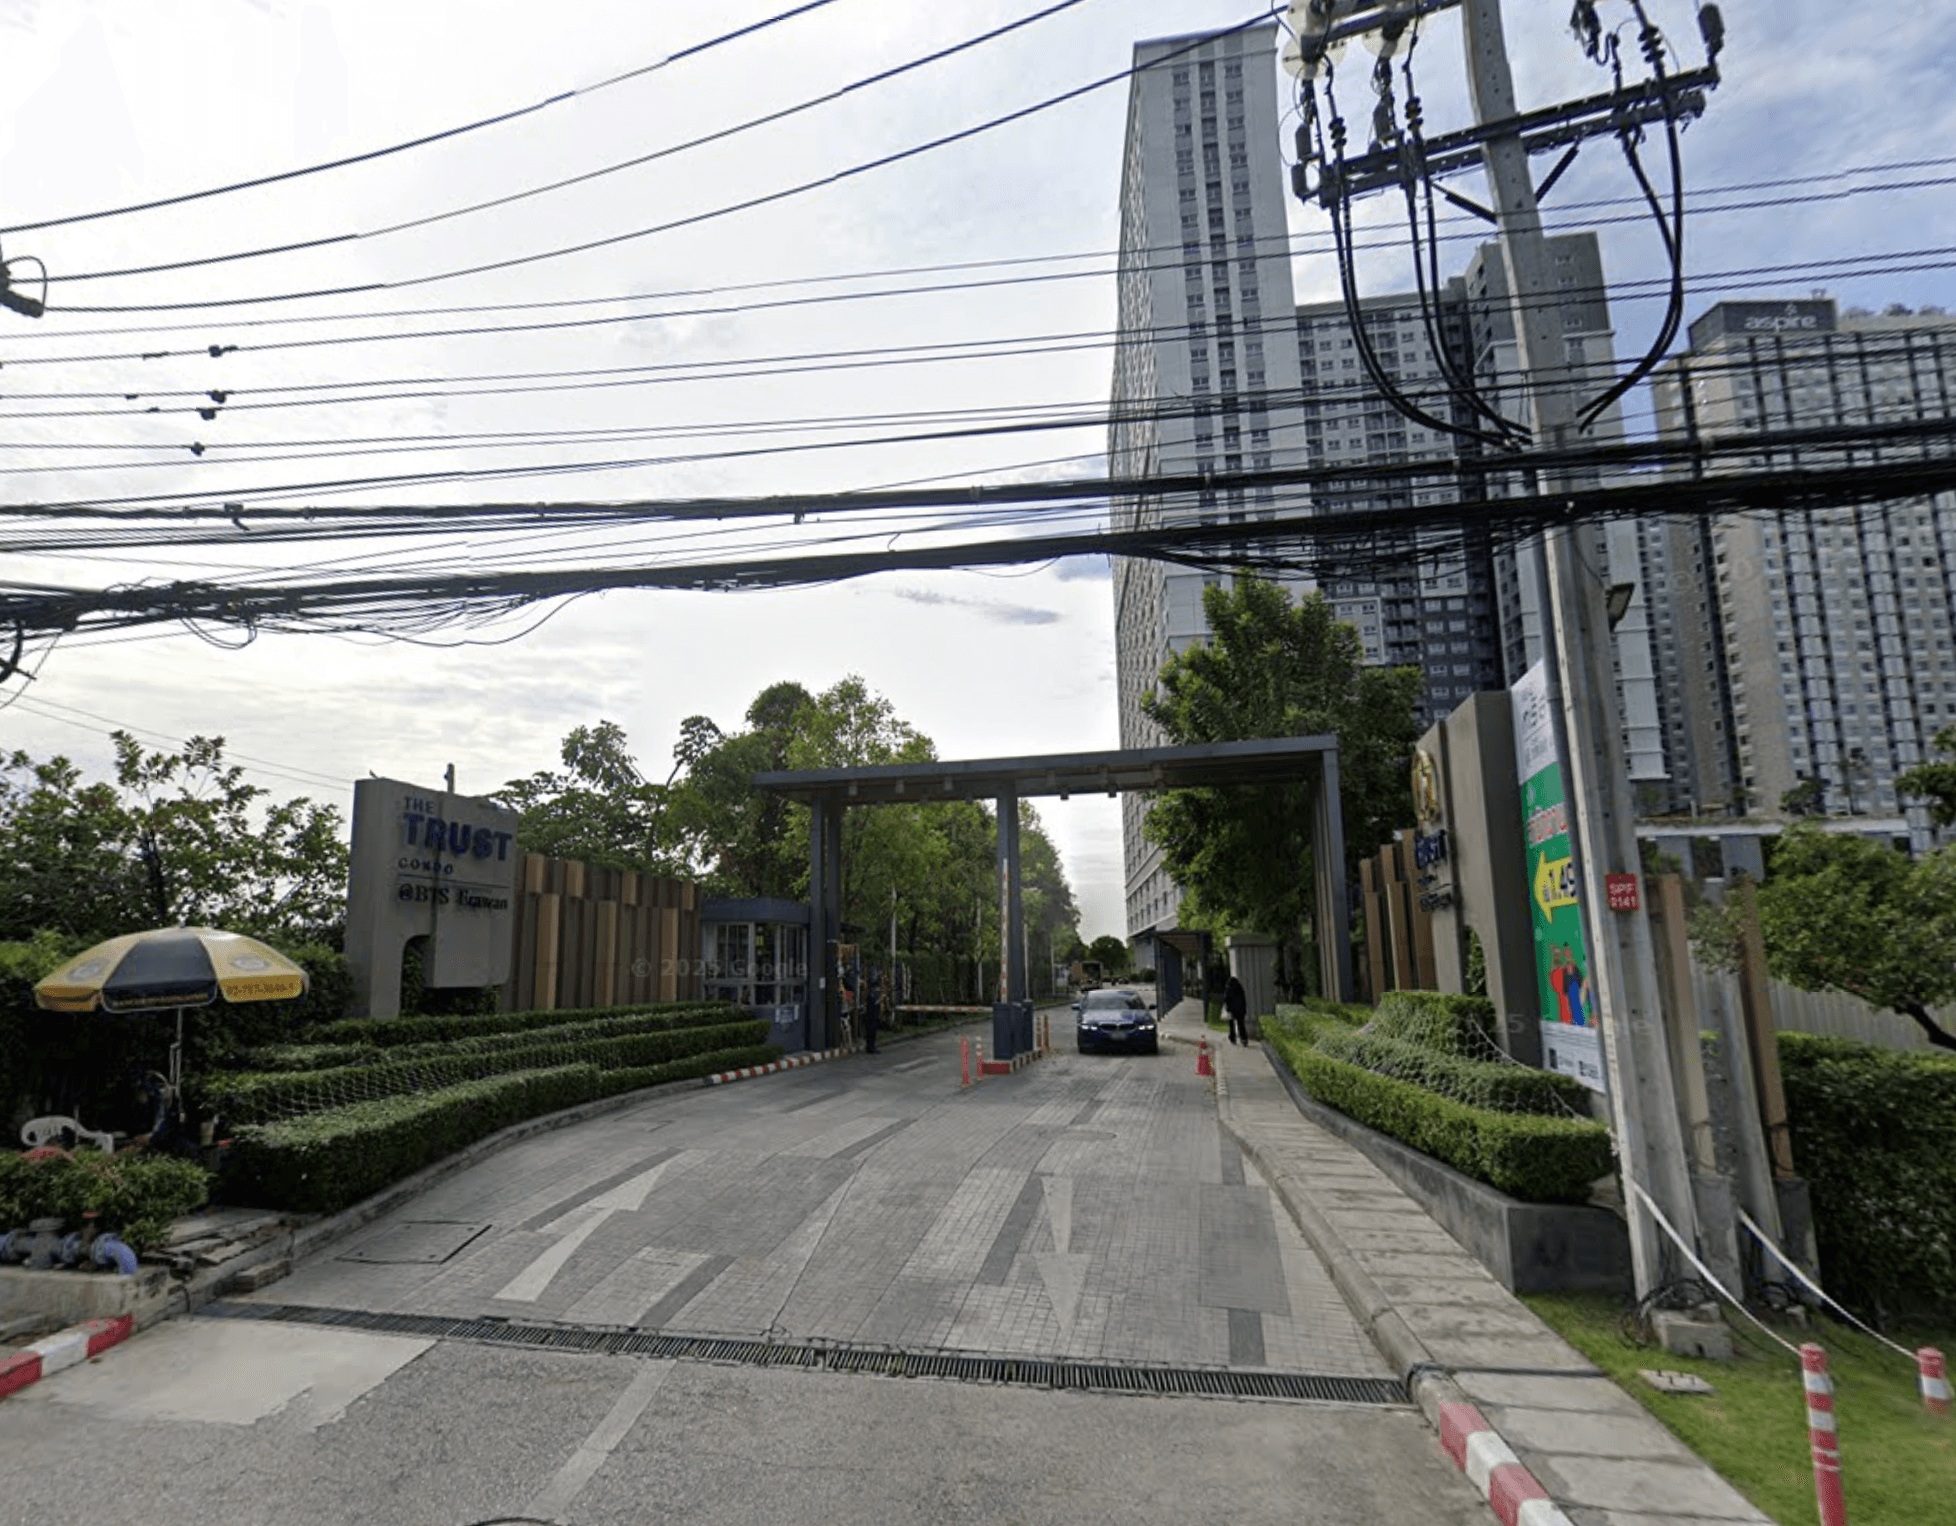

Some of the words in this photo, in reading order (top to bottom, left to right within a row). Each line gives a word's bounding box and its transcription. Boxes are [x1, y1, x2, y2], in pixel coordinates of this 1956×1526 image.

[1744, 313, 1818, 335] aspire
[404, 795, 435, 815] THE
[403, 812, 513, 862] TRUST
[398, 857, 454, 875] CONDO
